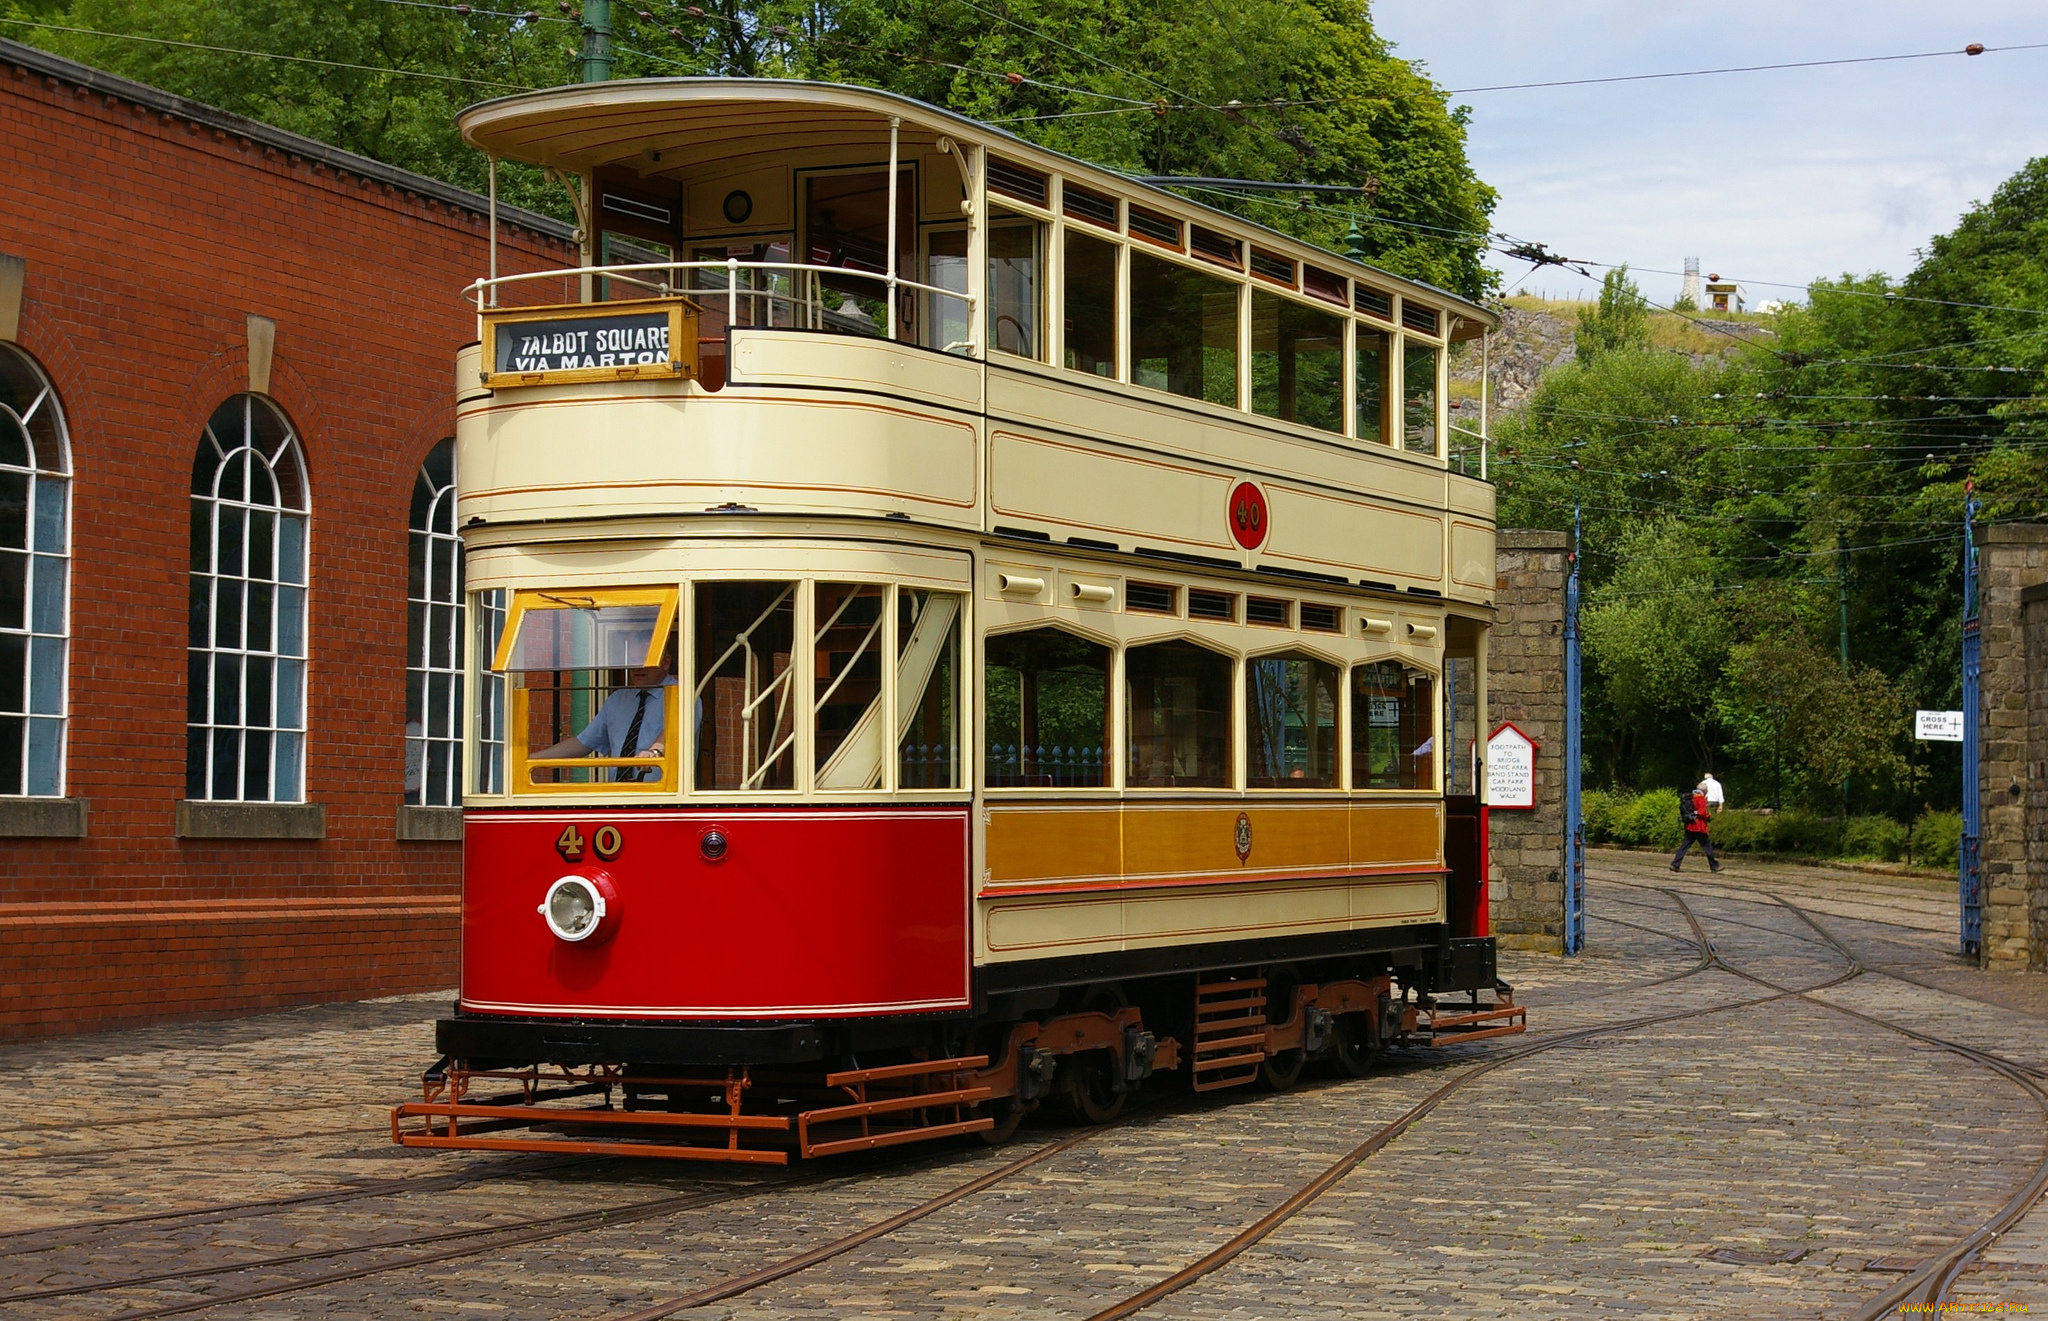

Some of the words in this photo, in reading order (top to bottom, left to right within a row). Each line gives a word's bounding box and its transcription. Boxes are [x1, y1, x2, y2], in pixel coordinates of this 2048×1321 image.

[520, 331, 589, 356] TALBOT
[595, 326, 669, 352] SQUARE
[515, 357, 551, 371] VIA
[560, 350, 670, 370] MARTON
[1237, 499, 1260, 530] 40
[556, 825, 622, 862] 40
